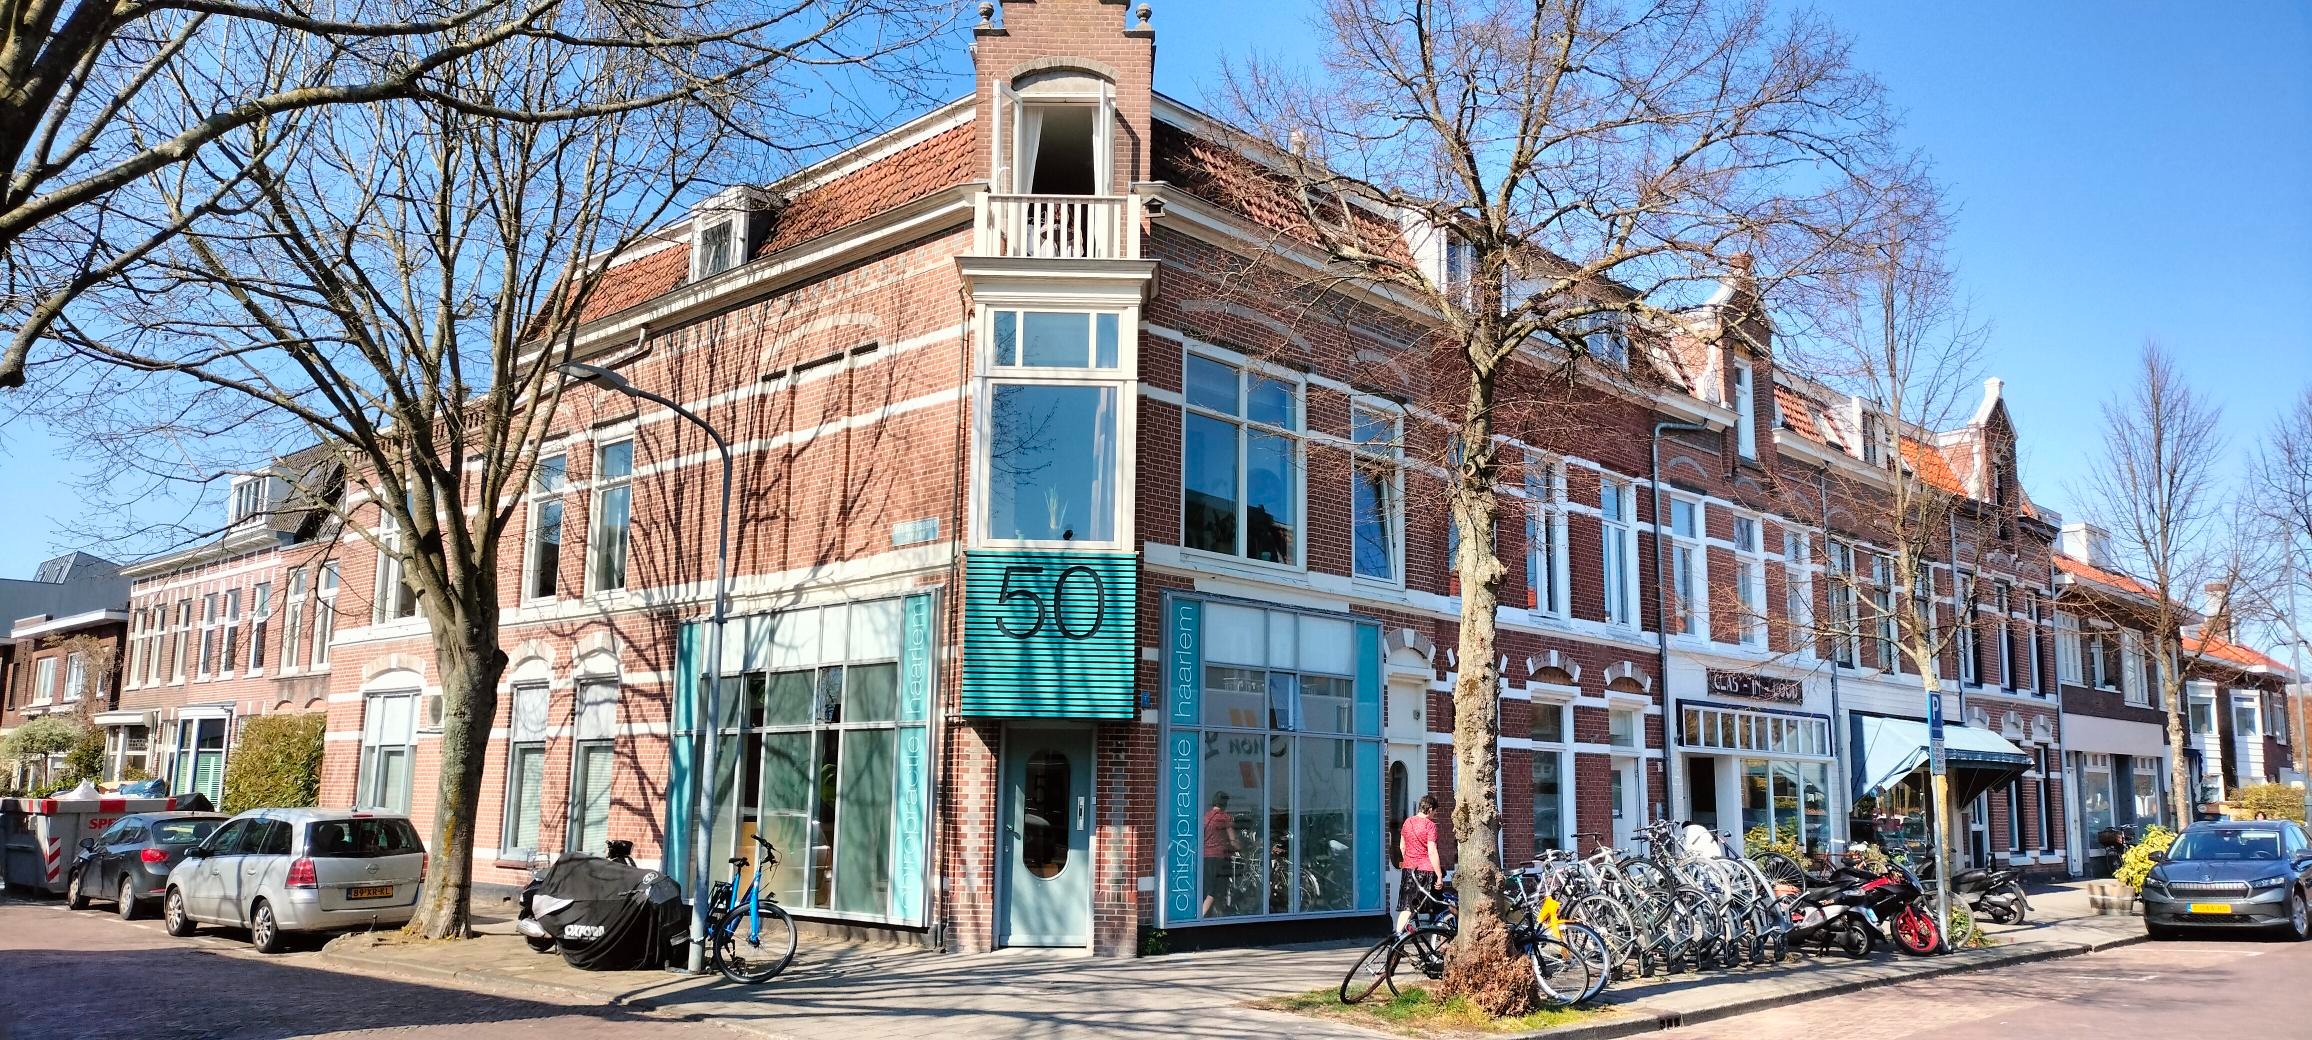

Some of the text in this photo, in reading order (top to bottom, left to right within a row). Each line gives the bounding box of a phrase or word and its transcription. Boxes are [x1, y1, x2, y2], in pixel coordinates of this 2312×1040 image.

[996, 566, 1105, 640] 50
[1751, 679, 1761, 695] IN
[1931, 695, 1940, 720] P
[902, 602, 925, 910] chiropractie haarlem
[1172, 606, 1193, 911] chiropractie haarlem
[564, 924, 605, 938] OXFORD
